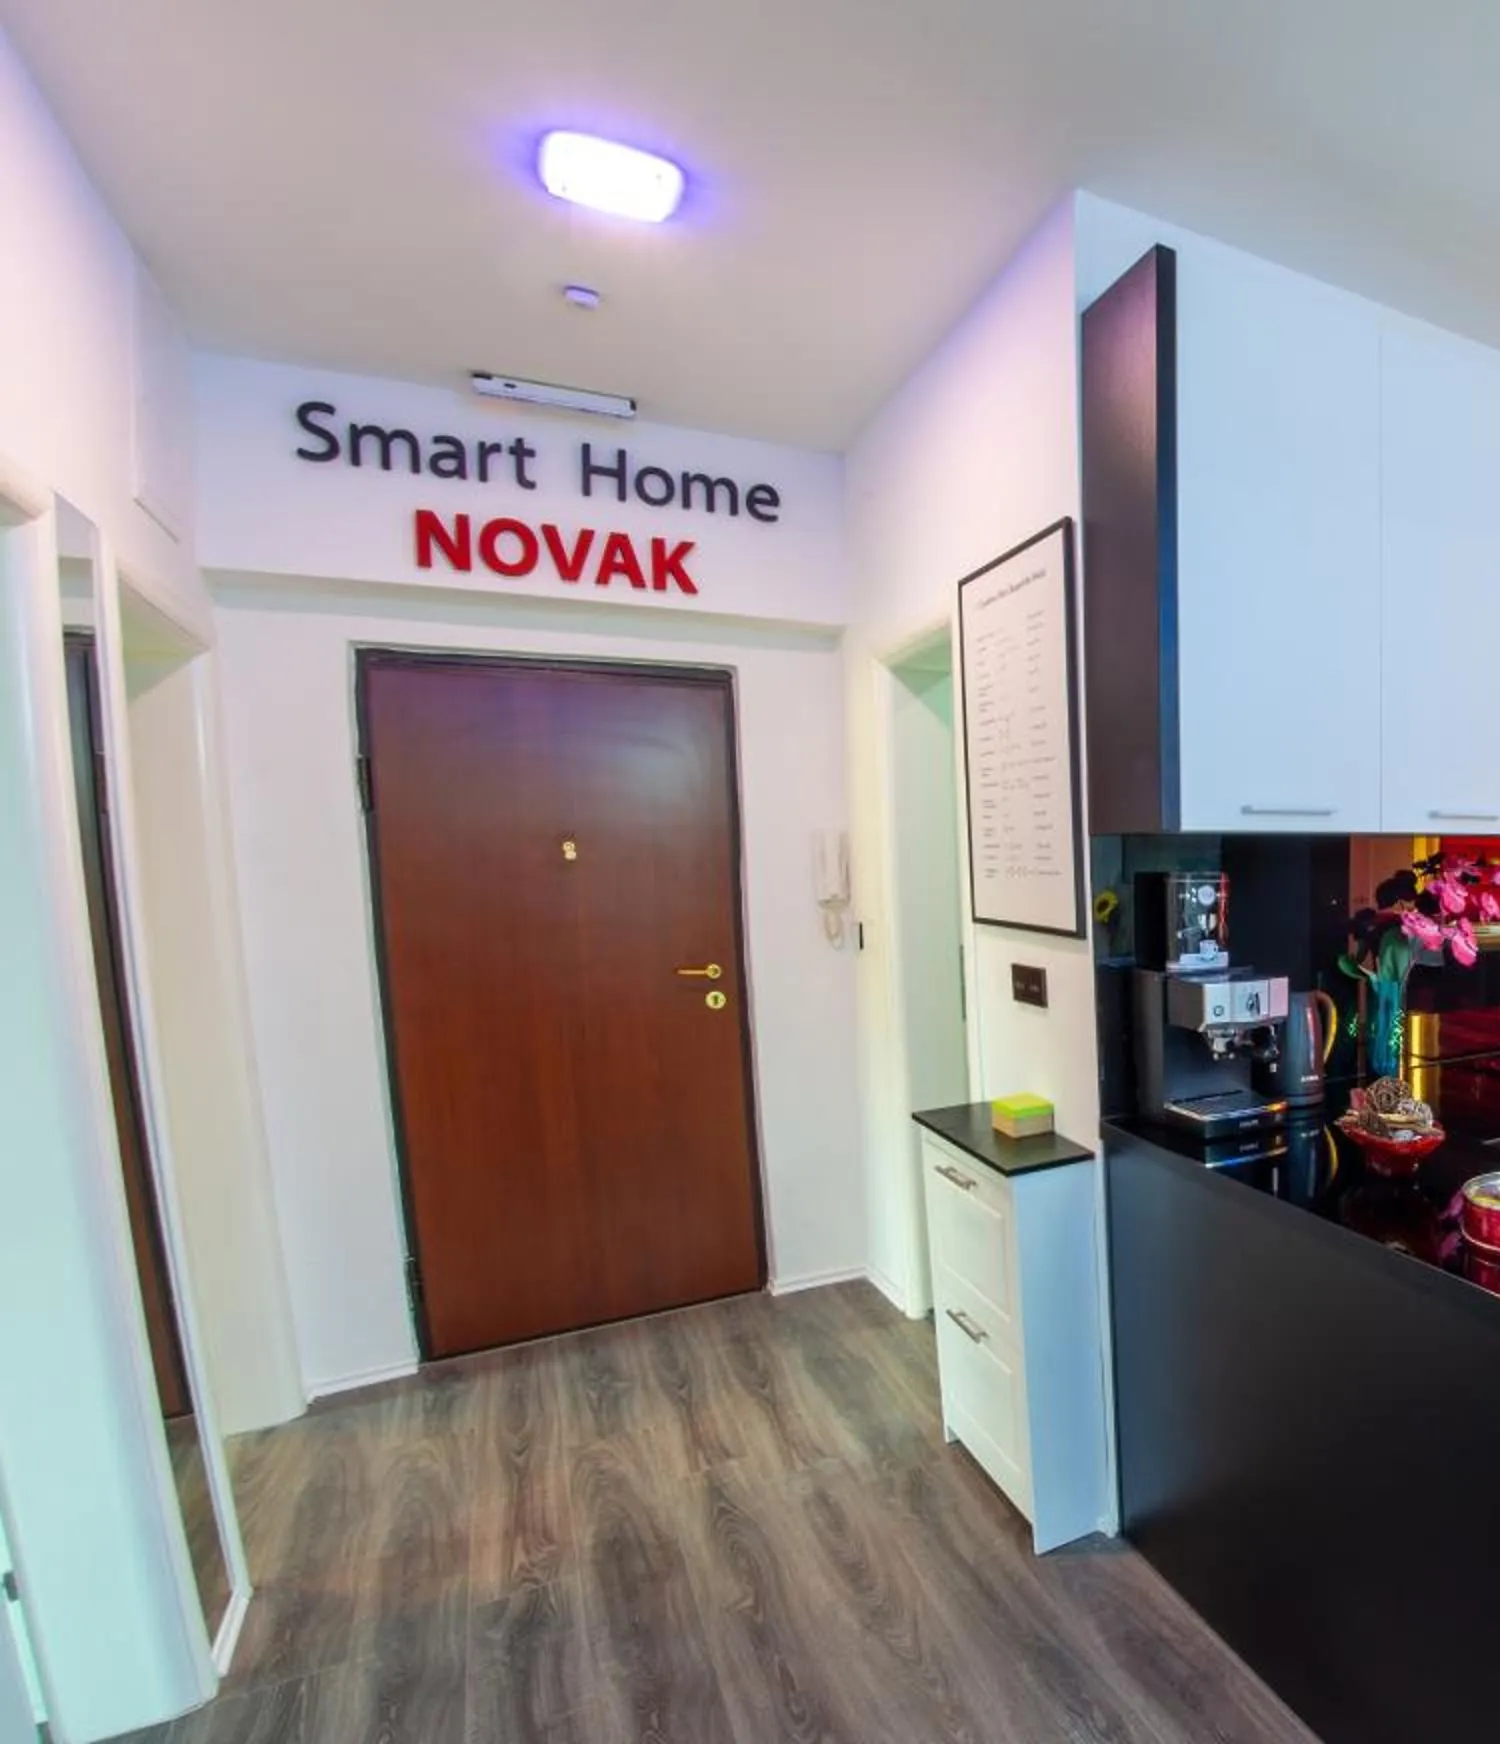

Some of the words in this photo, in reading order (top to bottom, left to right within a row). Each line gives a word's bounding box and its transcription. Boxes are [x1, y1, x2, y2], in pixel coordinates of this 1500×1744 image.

[295, 400, 537, 490] Smart
[580, 442, 781, 523] Home
[414, 509, 698, 595] NOVAK
